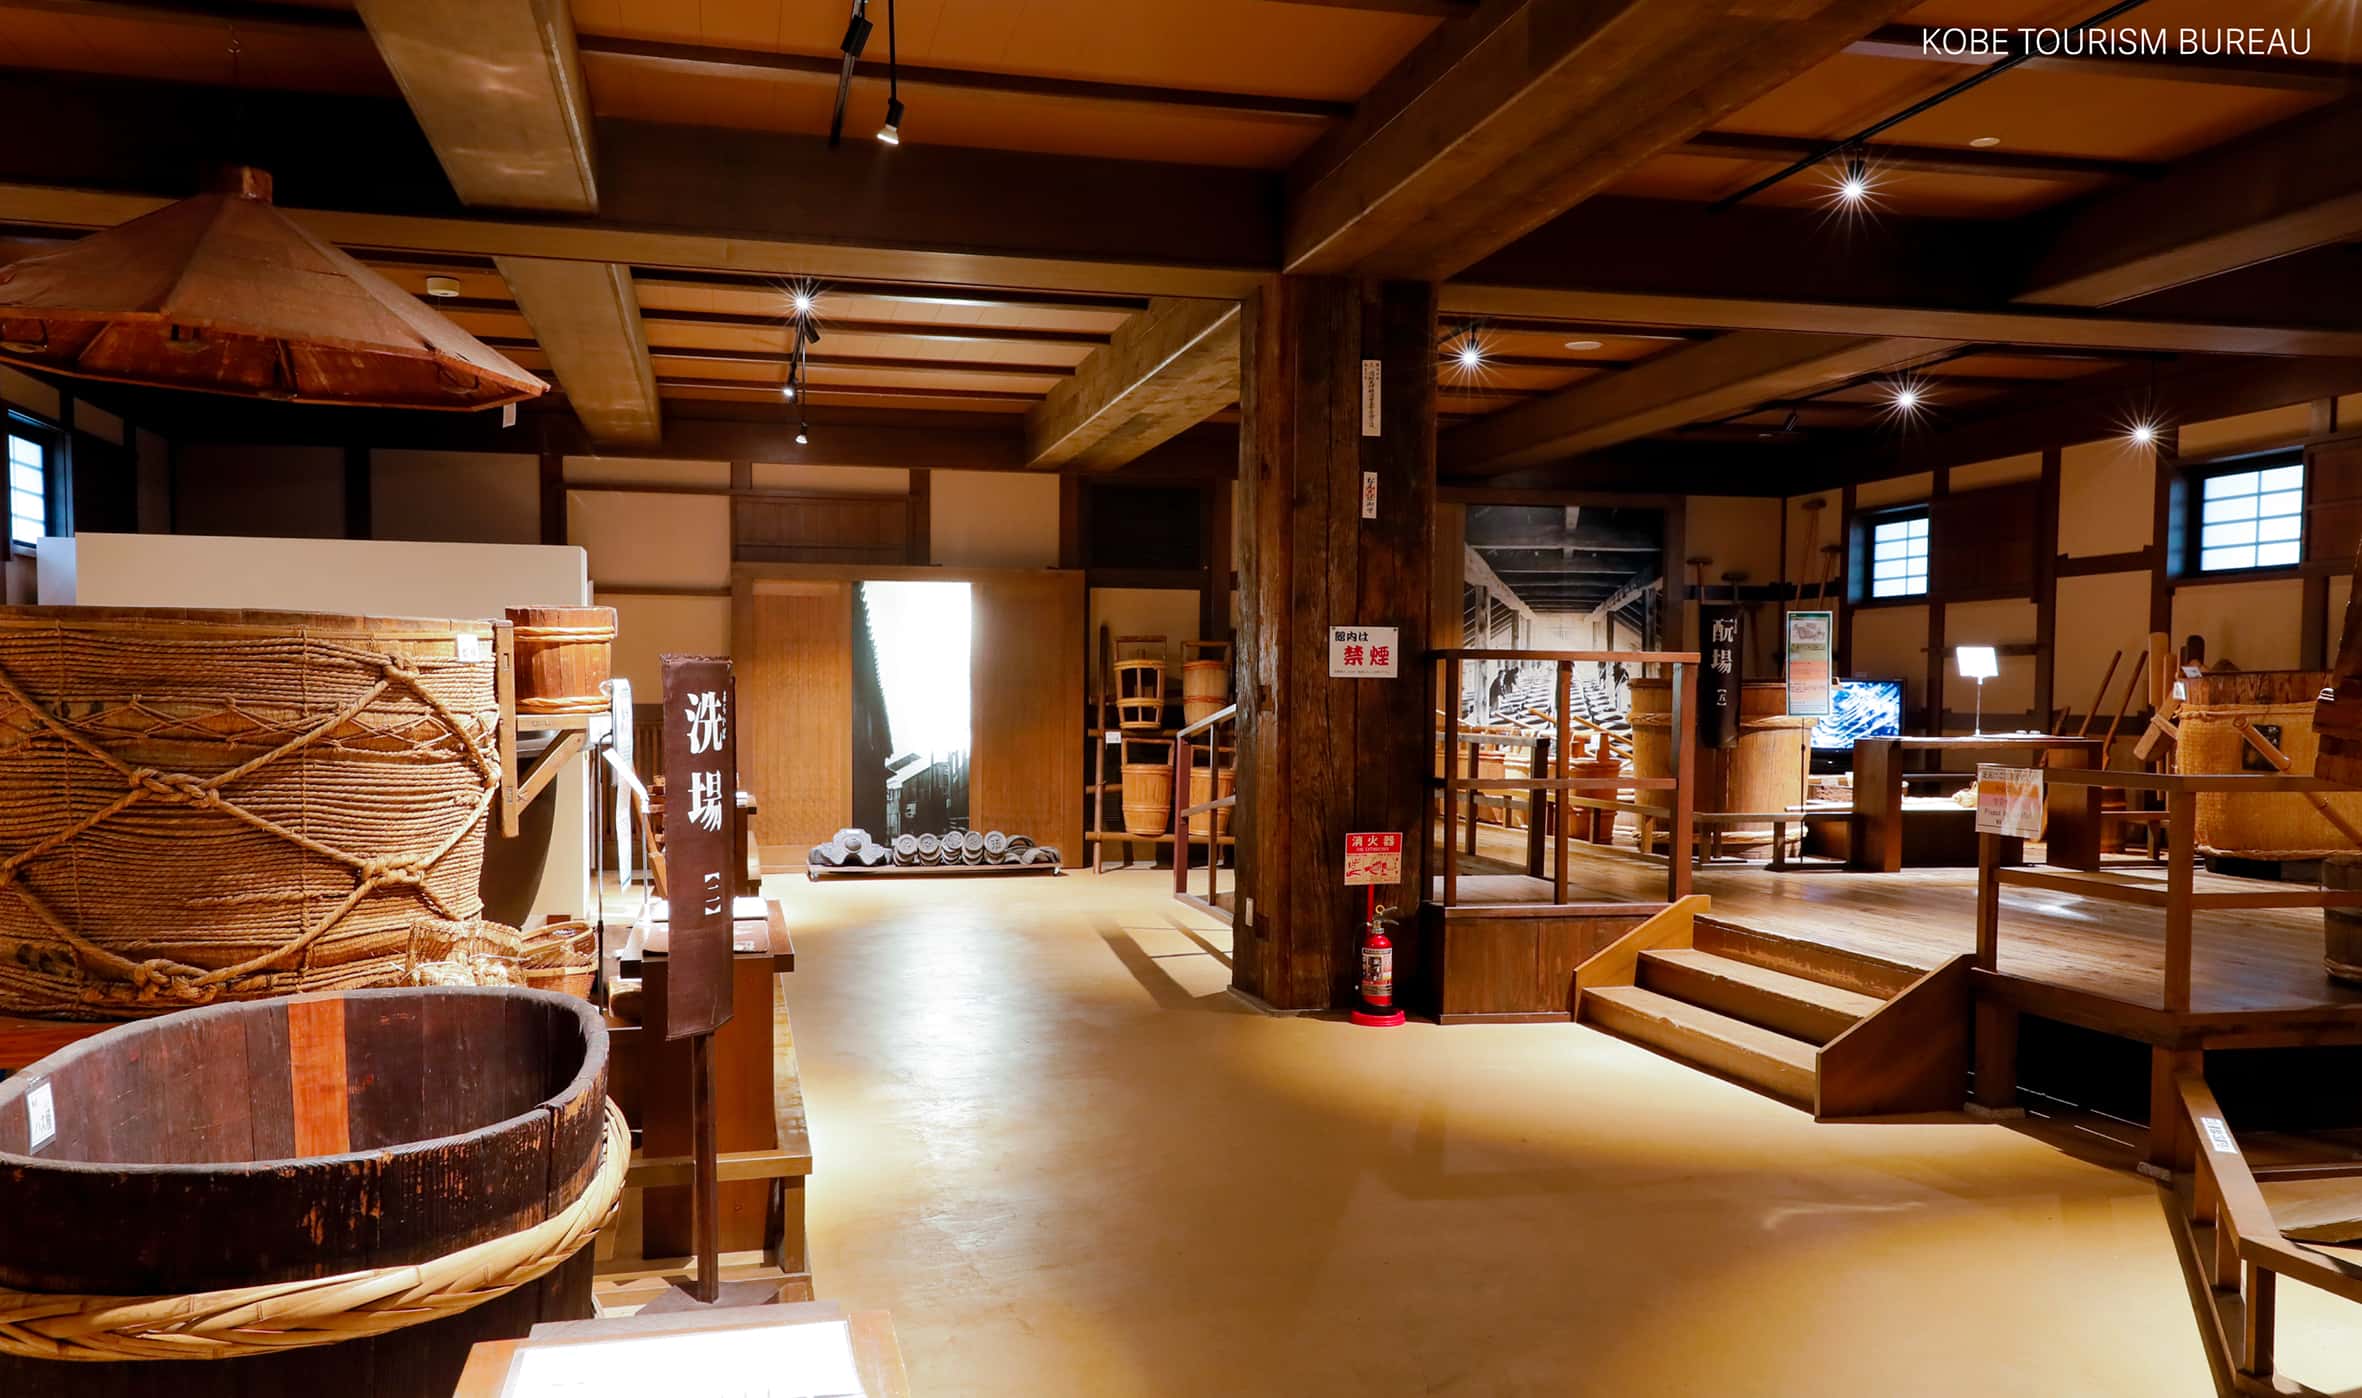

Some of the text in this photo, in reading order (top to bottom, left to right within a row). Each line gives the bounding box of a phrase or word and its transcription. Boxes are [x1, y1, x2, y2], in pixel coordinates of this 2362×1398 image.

[1335, 631, 1369, 642] 館内は
[1344, 645, 1390, 666] 禁煙
[685, 691, 722, 832] 洗場
[1352, 836, 1395, 847] 消火器
